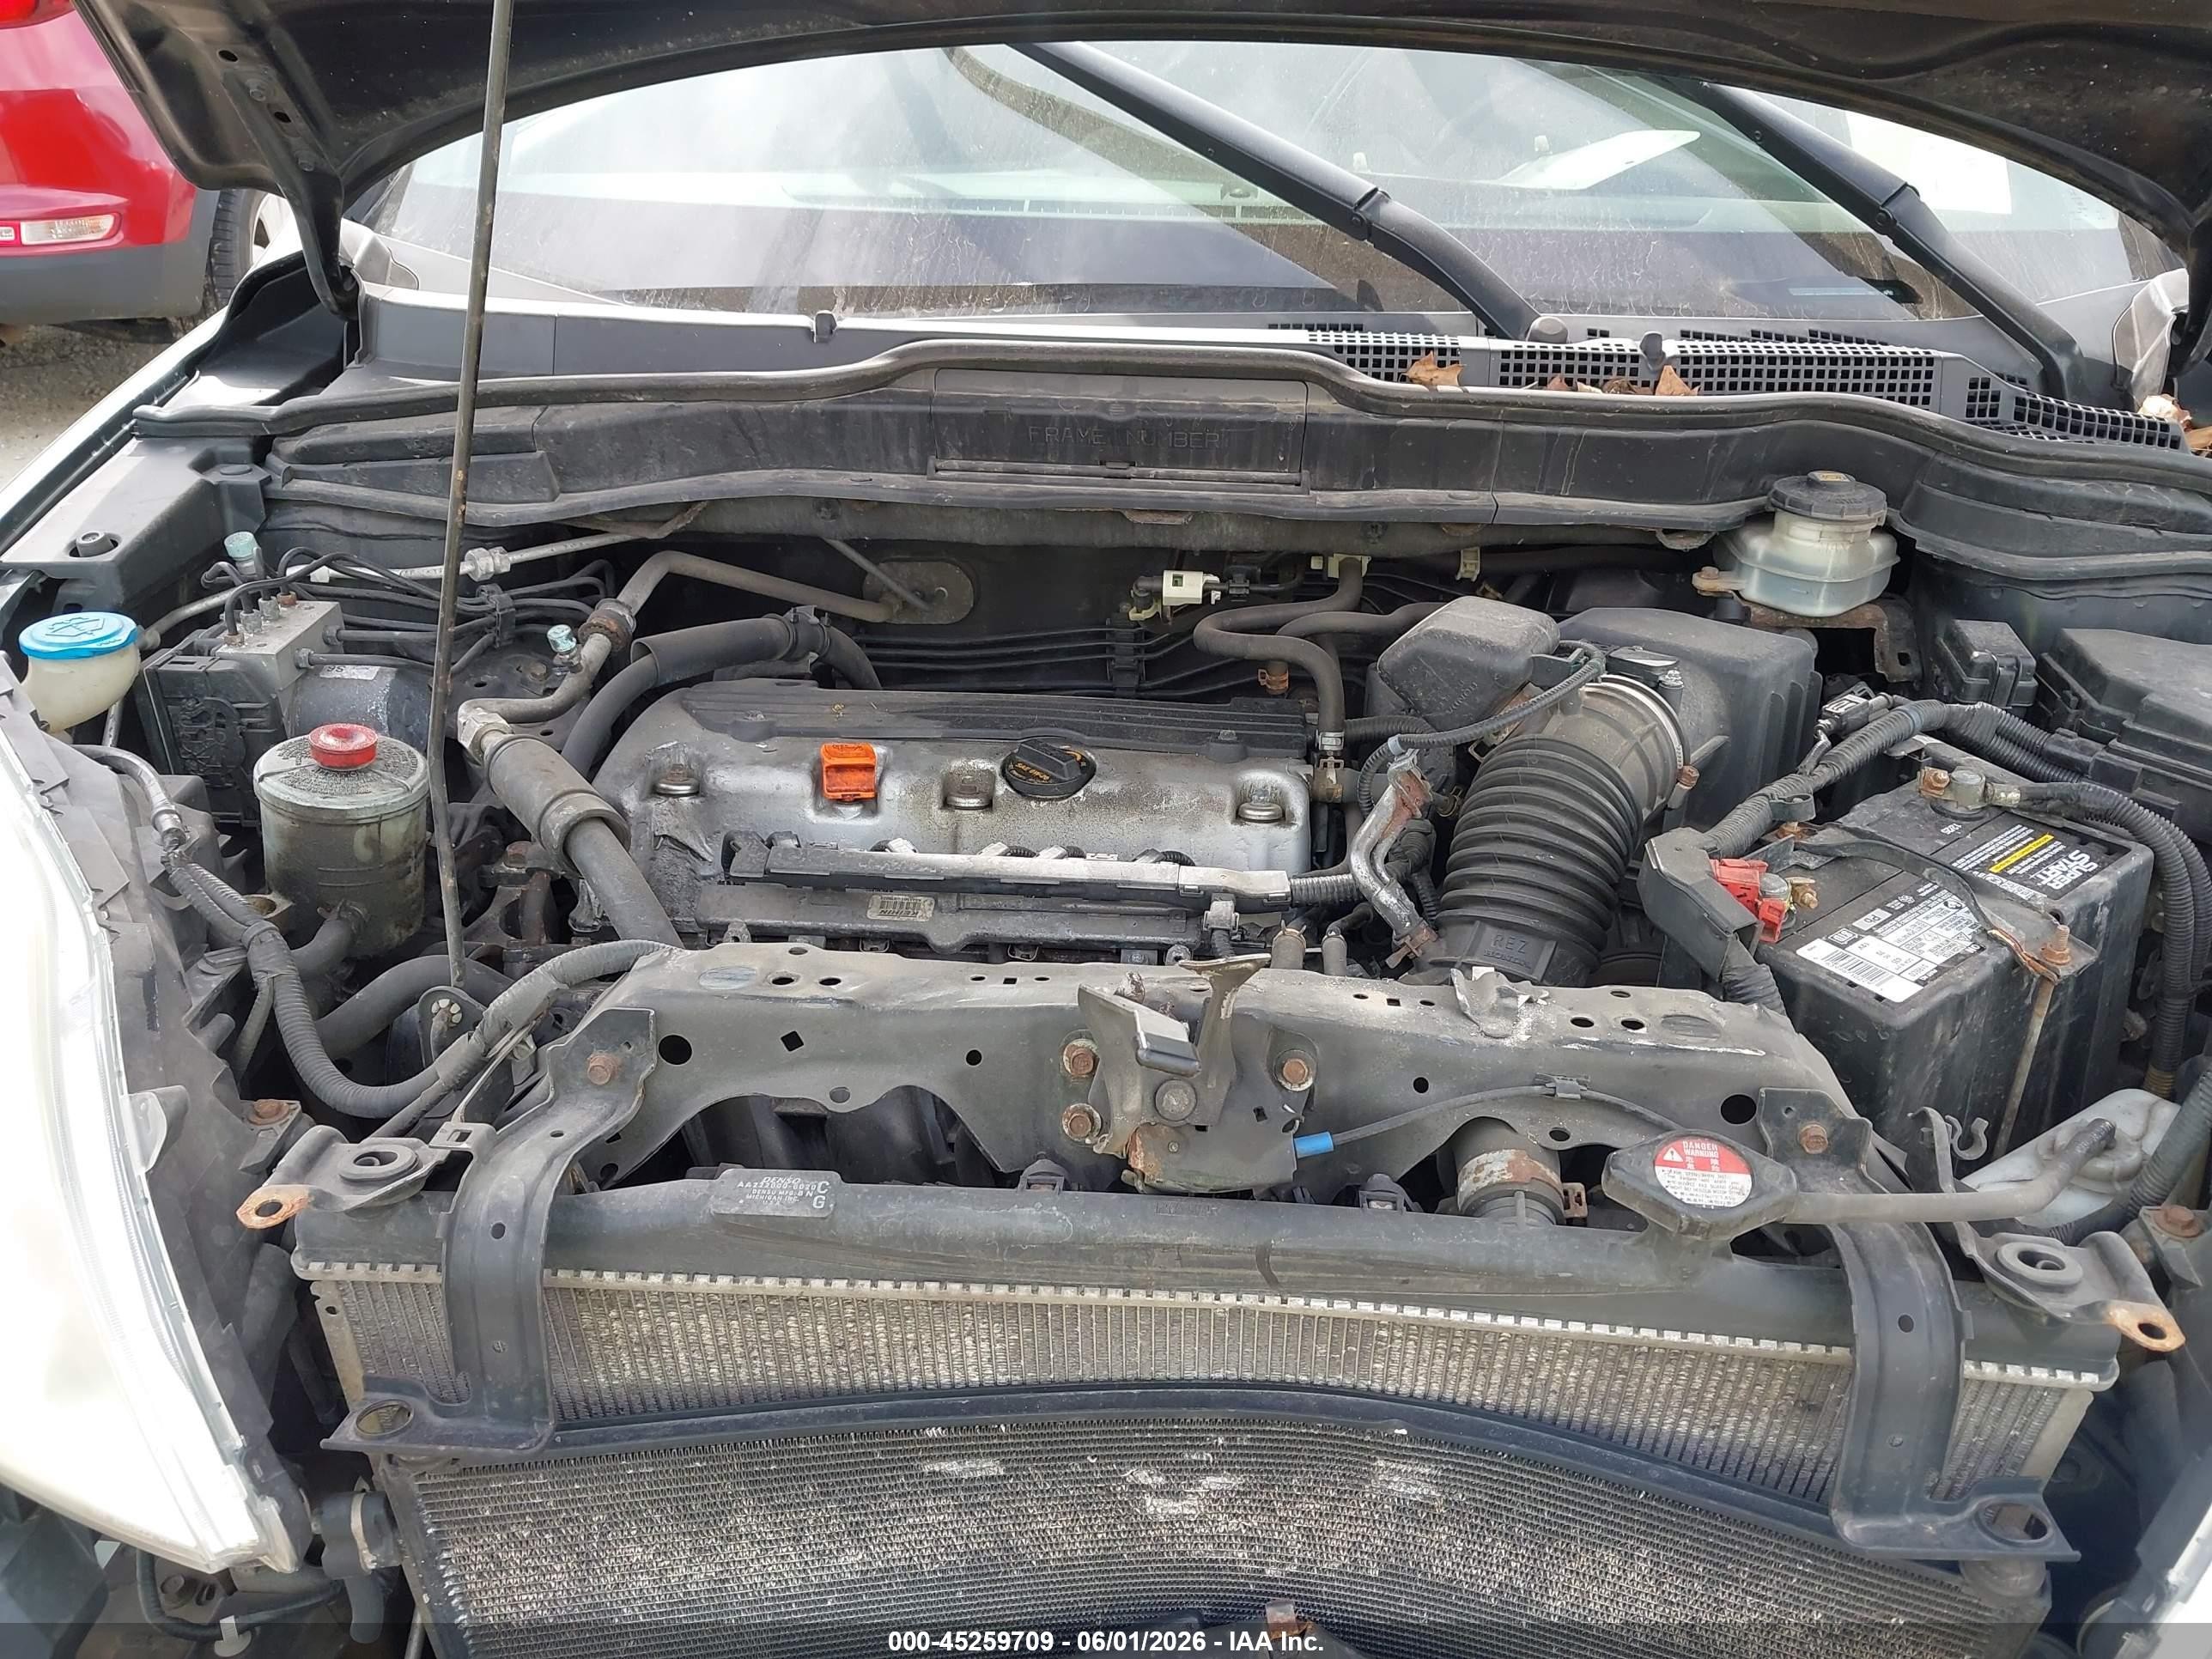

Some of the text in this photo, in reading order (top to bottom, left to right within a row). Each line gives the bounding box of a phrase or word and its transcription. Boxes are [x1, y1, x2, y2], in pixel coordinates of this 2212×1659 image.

[1029, 427, 1220, 449] FRAME NUMBER
[2041, 850, 2091, 885] START
[2048, 858, 2099, 890] SUPER
[1864, 913, 1881, 924] Pb
[1833, 930, 1852, 942] STD
[1683, 1140, 1718, 1152] DANGER
[1684, 1149, 1719, 1158] WARNUNG
[817, 1181, 830, 1194] C
[812, 1194, 826, 1209] G
